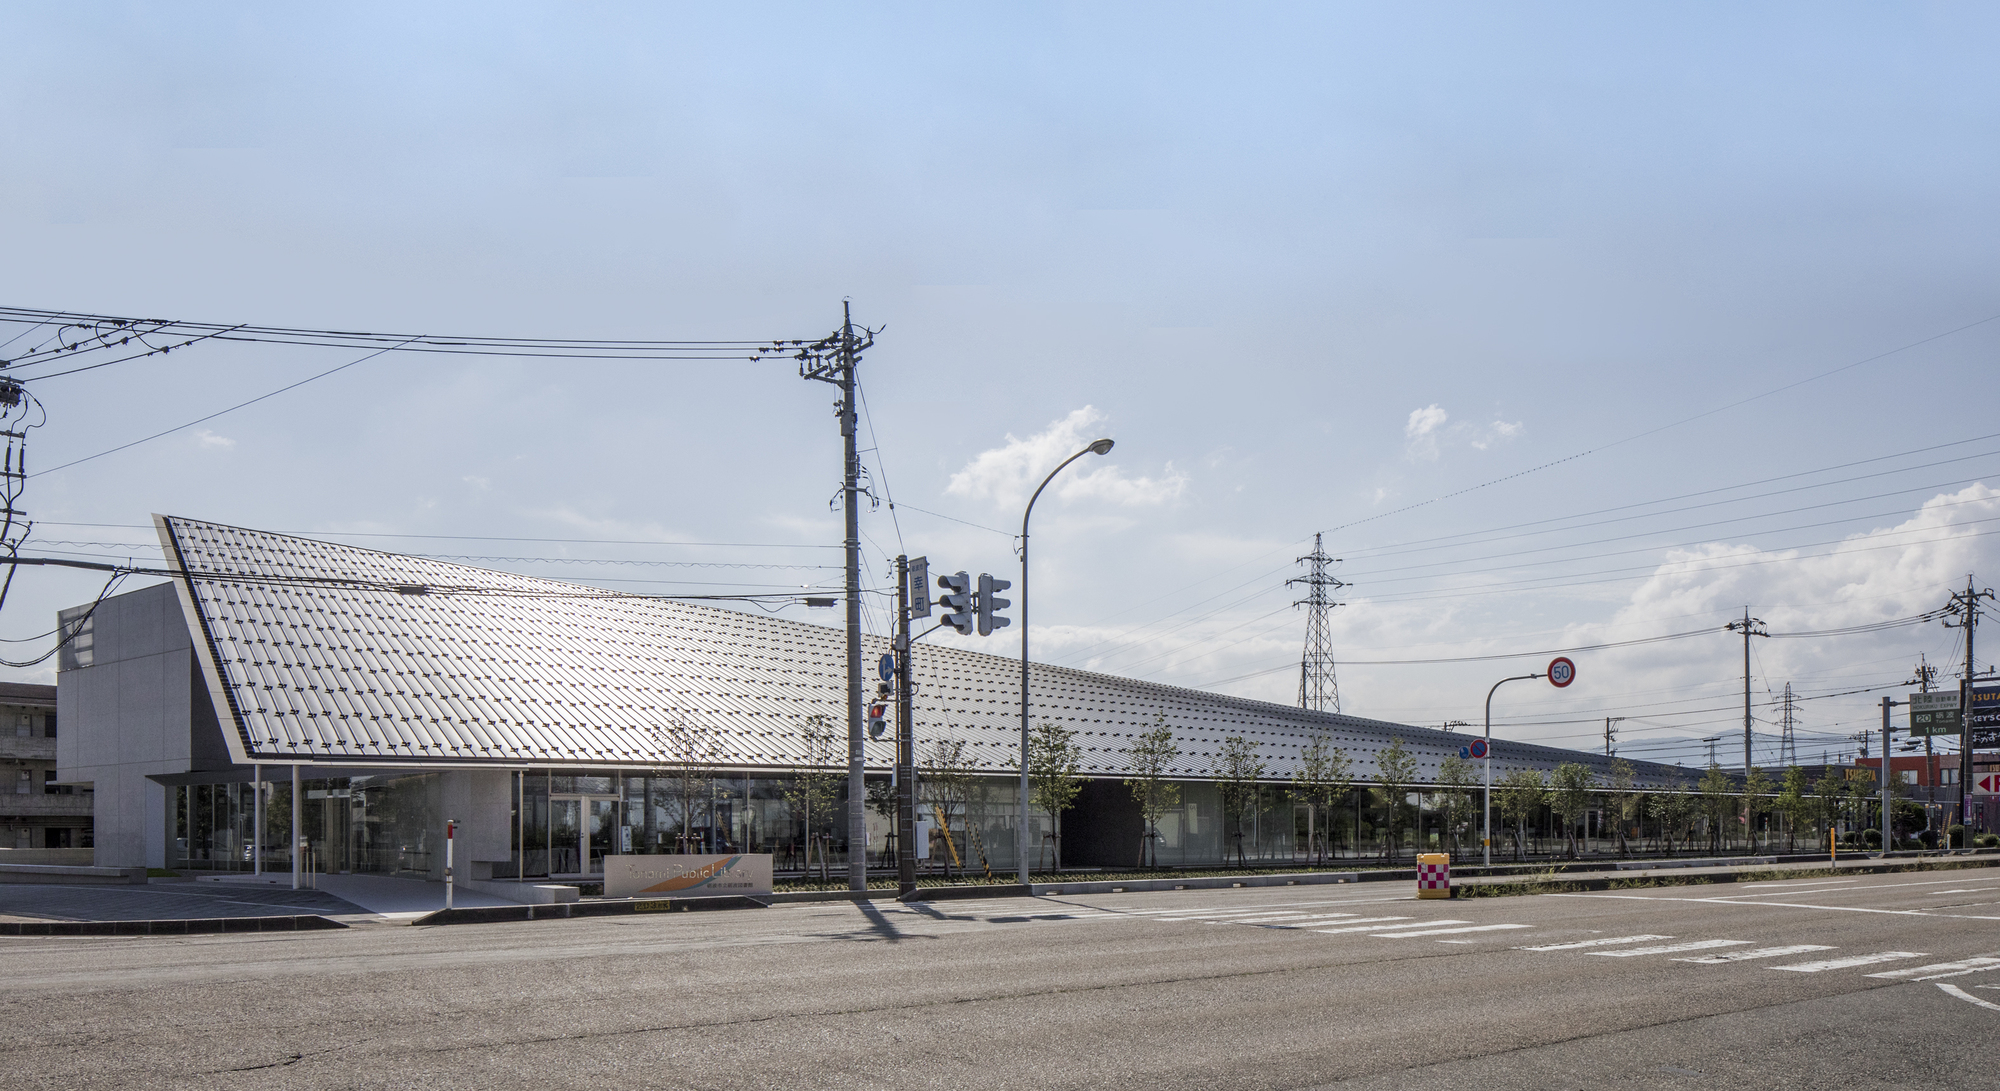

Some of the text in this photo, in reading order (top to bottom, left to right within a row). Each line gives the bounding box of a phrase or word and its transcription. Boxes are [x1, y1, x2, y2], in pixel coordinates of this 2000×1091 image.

[914, 576, 924, 611] 幸町
[1554, 665, 1569, 680] 50
[626, 863, 754, 881] Tonami Public Library
